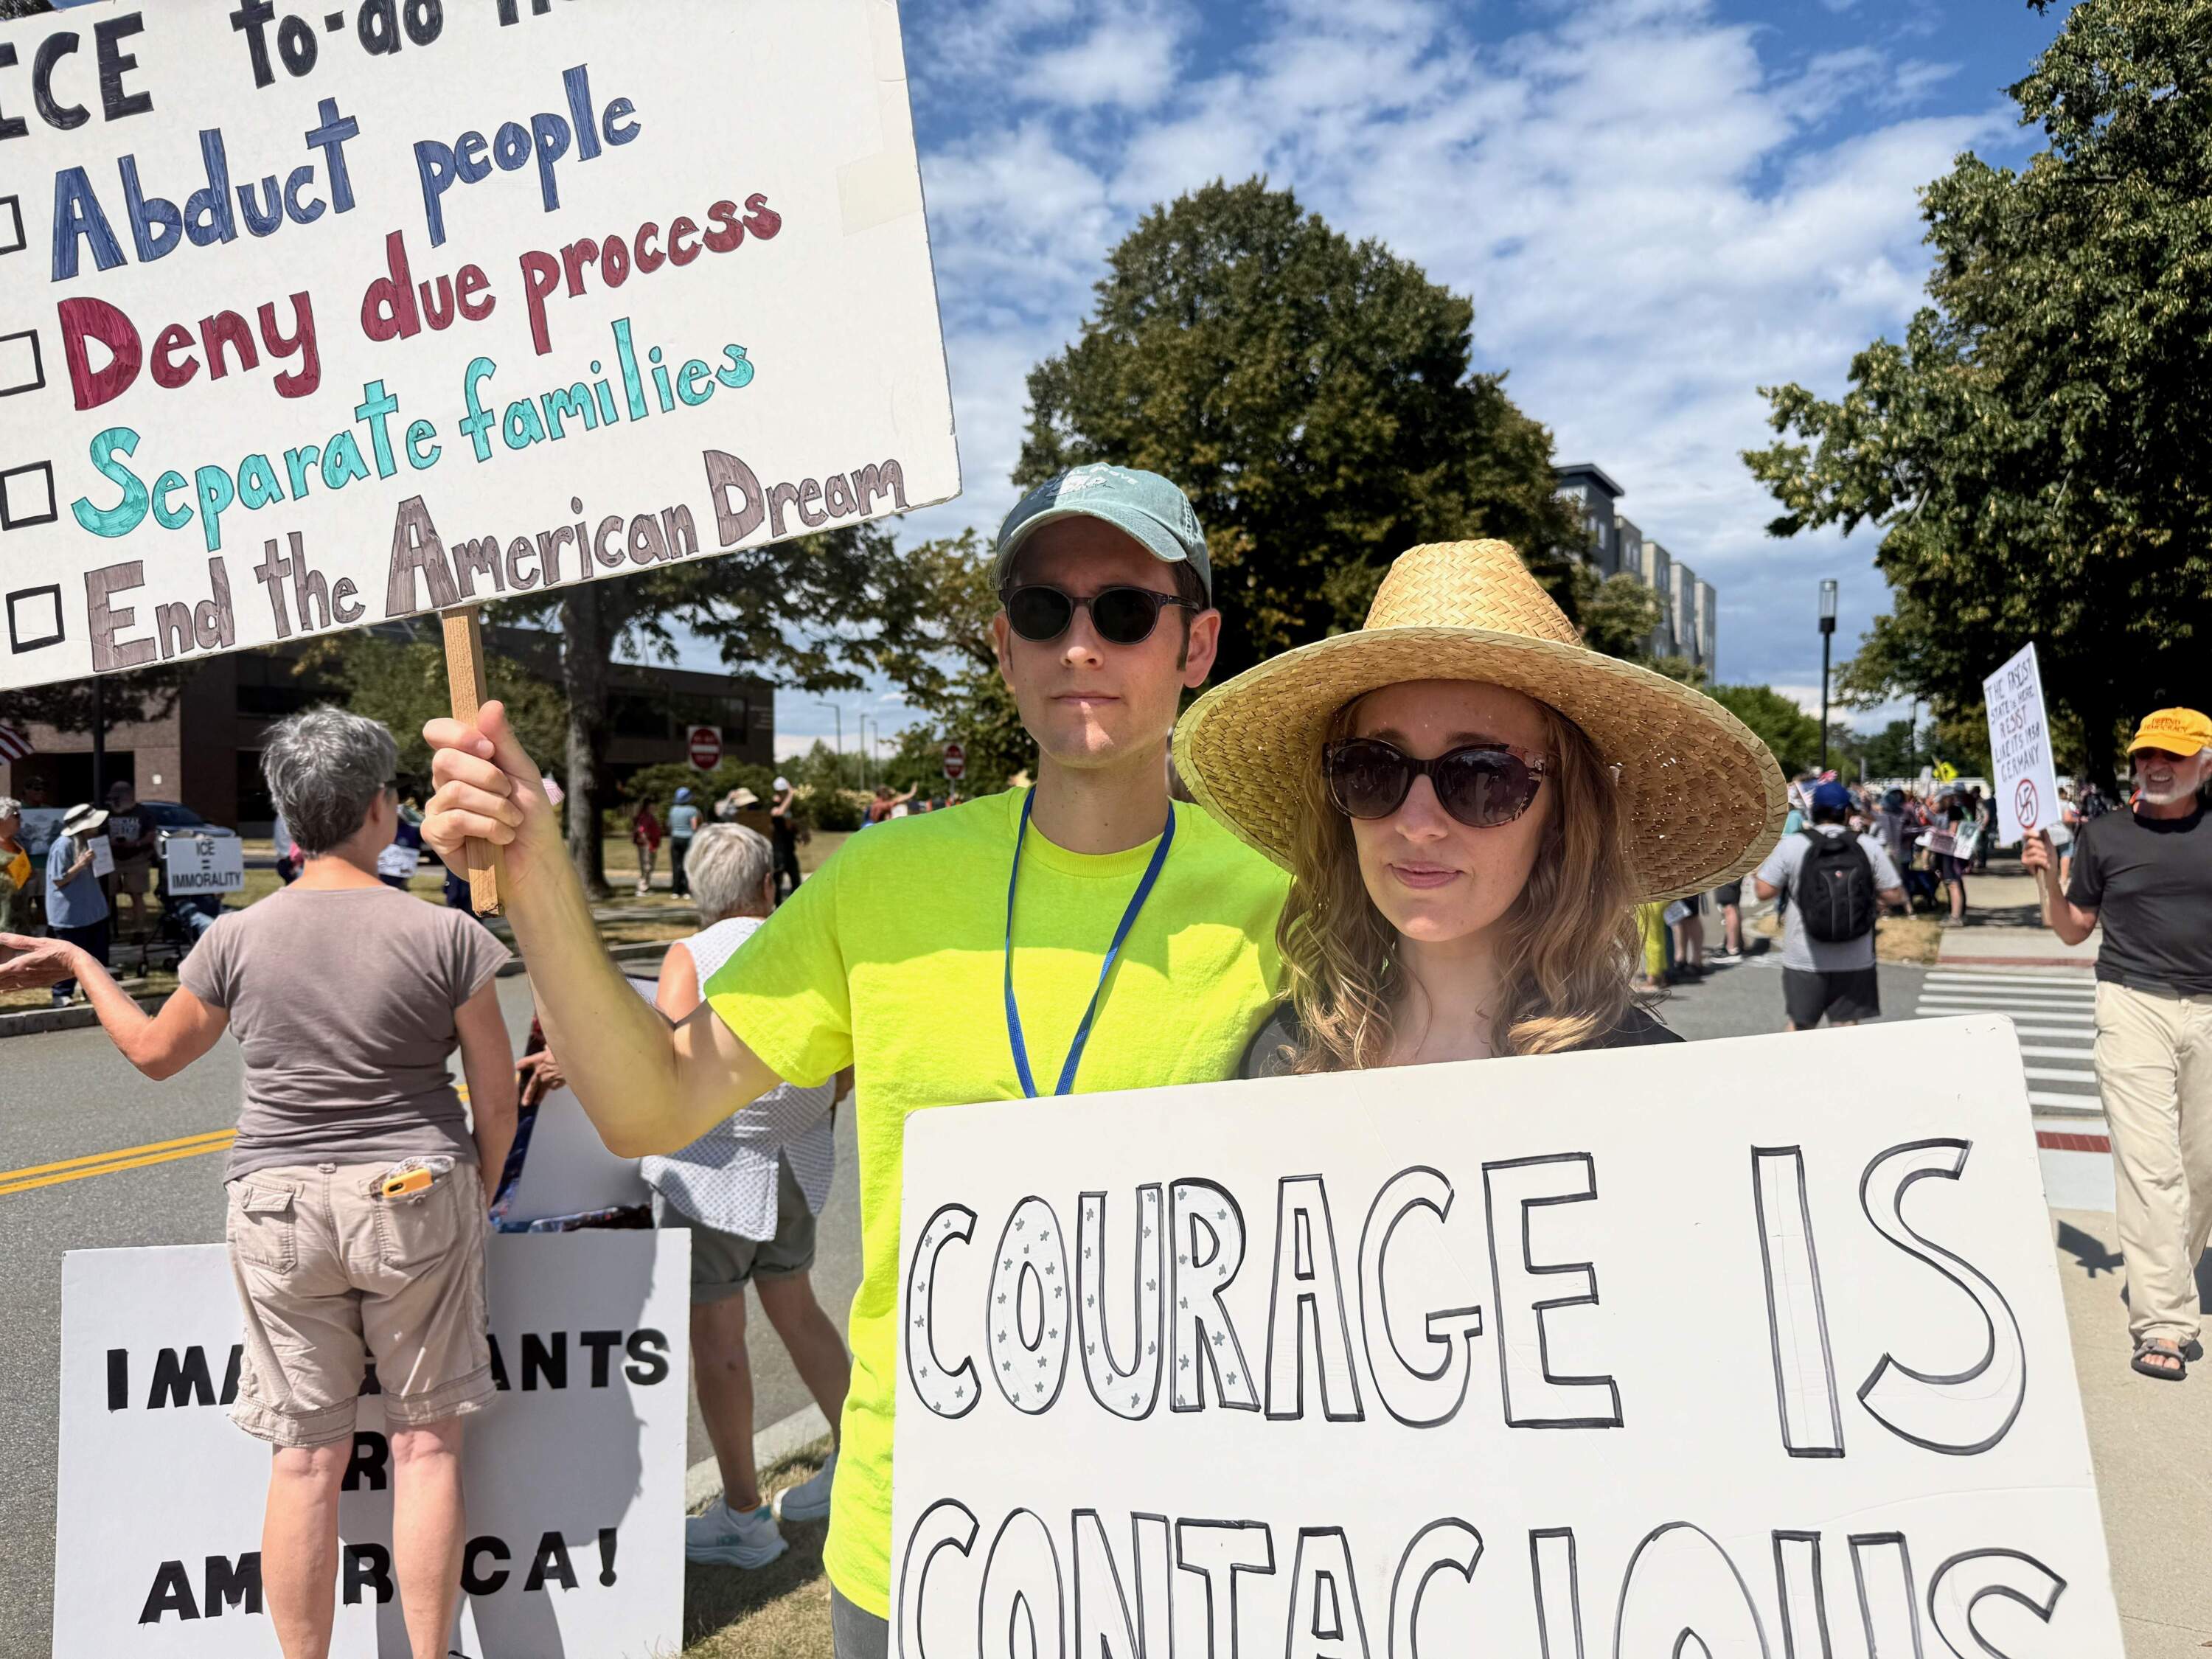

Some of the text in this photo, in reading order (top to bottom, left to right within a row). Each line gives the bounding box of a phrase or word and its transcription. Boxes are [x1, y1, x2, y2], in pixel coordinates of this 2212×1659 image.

[229, 0, 444, 88] to-do
[51, 63, 641, 282] Abduct people
[58, 192, 782, 411] Deny due process
[71, 317, 754, 552] Separate families
[84, 449, 910, 672] End the American Dream
[1985, 678, 2004, 705] THE
[172, 872, 242, 889] IMMORALITY
[196, 841, 216, 857] ICE
[905, 1138, 2026, 1458] COURAGE IS
[139, 1527, 618, 1625] AMRCA!
